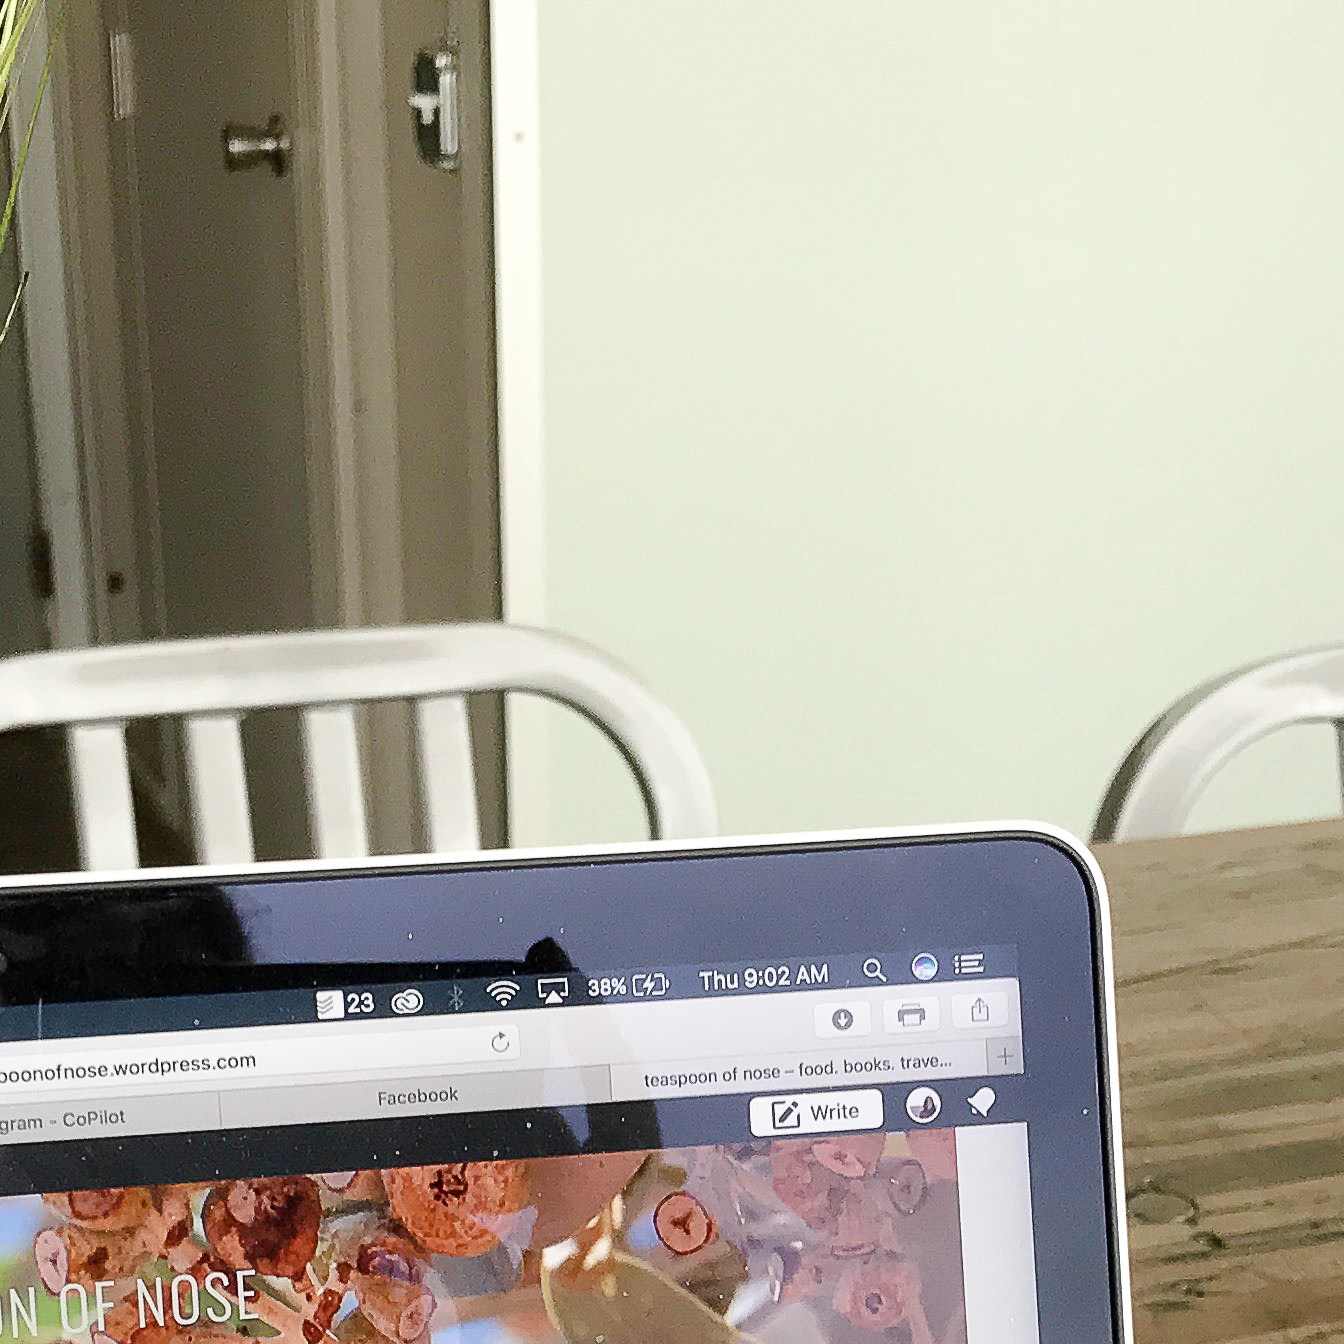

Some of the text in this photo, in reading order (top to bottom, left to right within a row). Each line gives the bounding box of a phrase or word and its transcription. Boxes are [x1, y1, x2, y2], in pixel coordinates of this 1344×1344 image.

[588, 976, 626, 997] 38%
[699, 964, 828, 991] Thu 9:02 AM
[347, 993, 374, 1014] 23
[644, 1071, 717, 1089] teaspoon
[723, 1068, 739, 1082] of
[743, 1066, 780, 1080] nose
[378, 1086, 459, 1108] Facebook
[63, 1109, 125, 1128] CoPilot
[811, 1104, 859, 1122] Write
[60, 1280, 116, 1334] OF
[136, 1269, 259, 1330] NOSE
